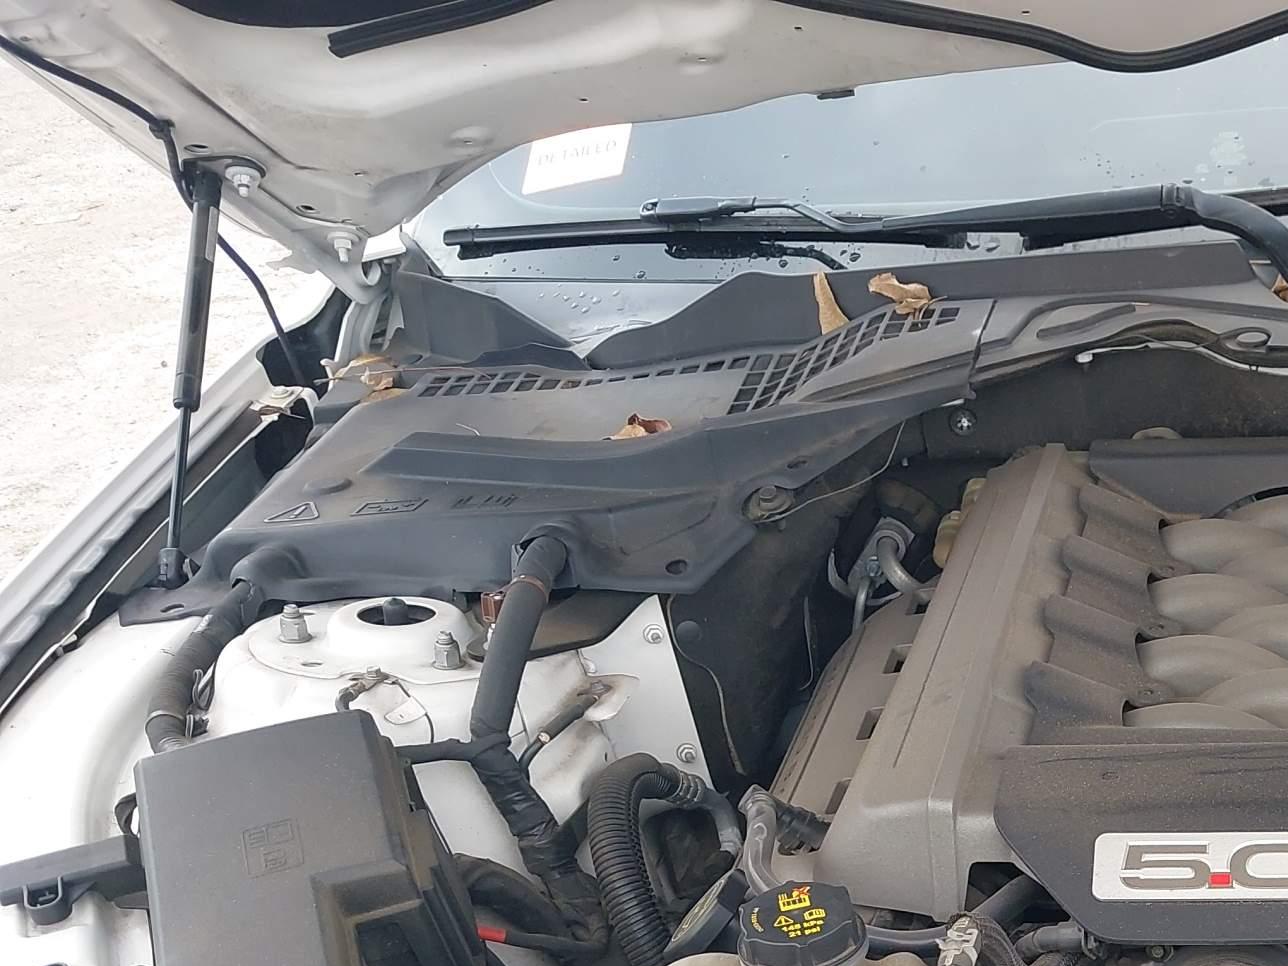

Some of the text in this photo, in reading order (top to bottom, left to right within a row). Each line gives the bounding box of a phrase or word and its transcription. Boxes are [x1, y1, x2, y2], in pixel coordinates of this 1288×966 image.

[539, 139, 618, 166] DETAILED
[788, 926, 821, 938] 21 psi
